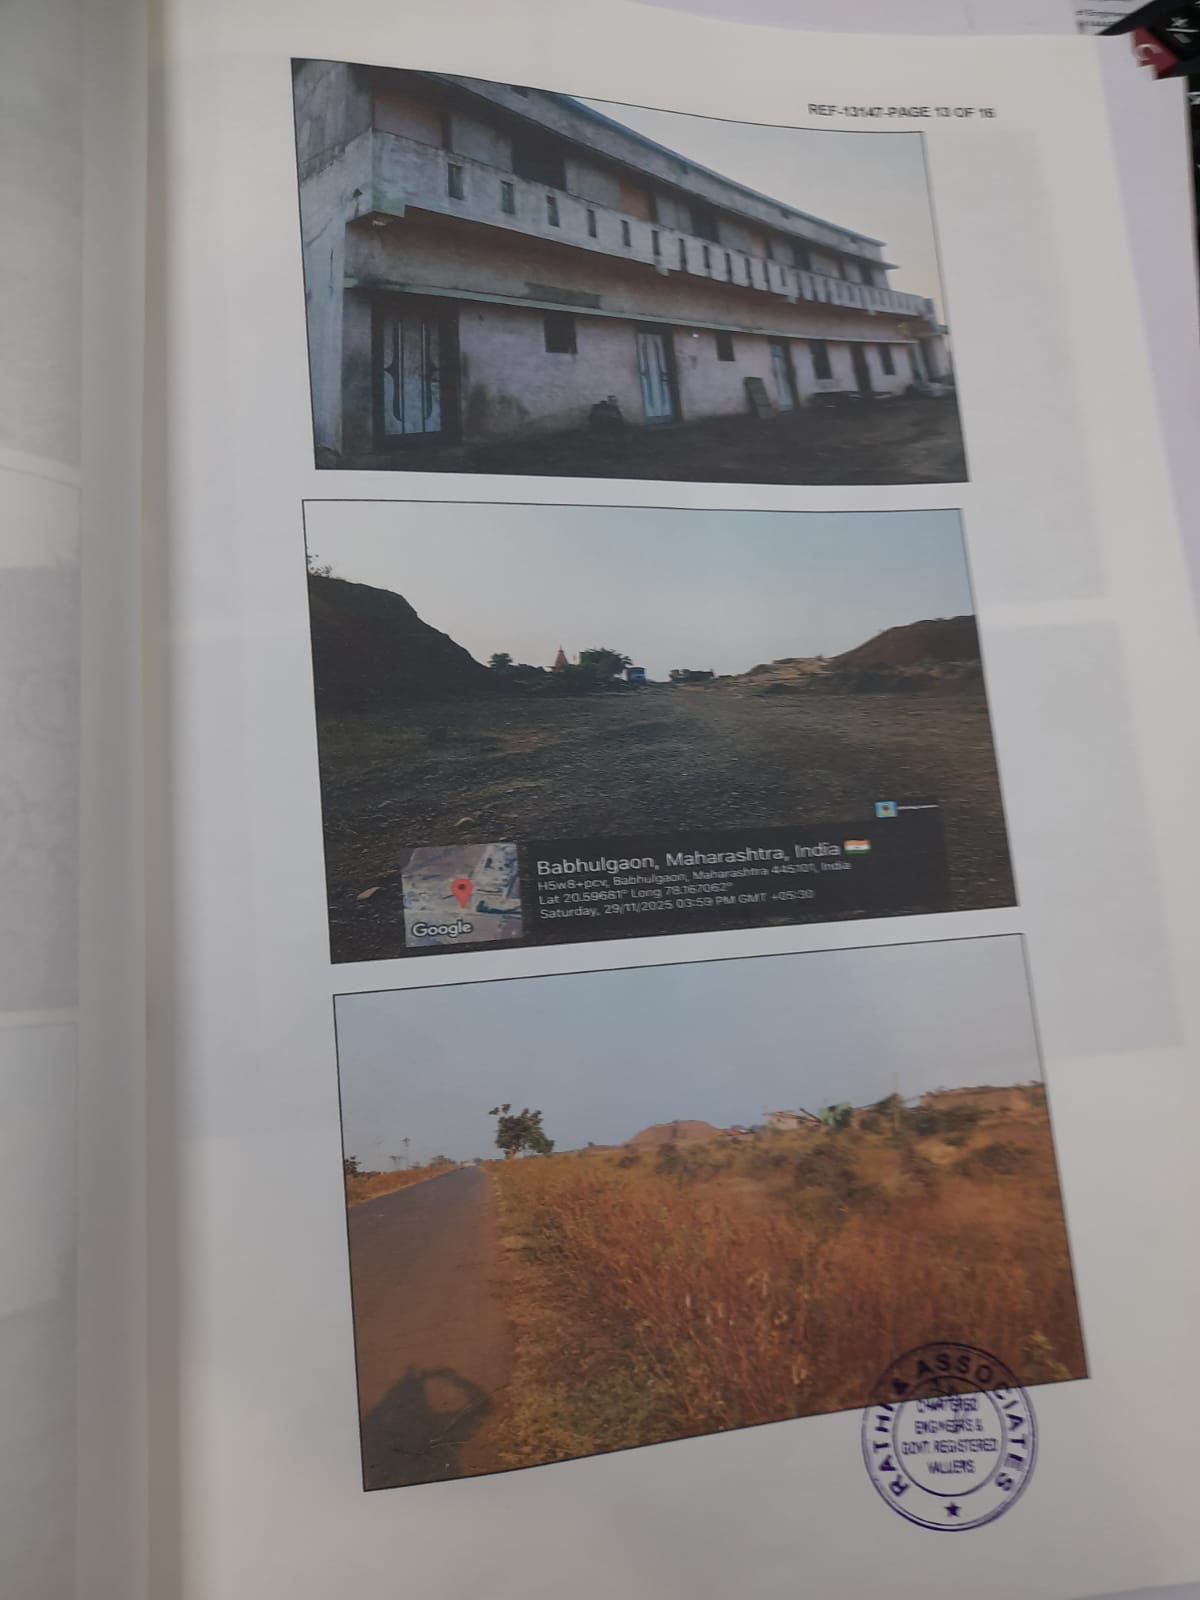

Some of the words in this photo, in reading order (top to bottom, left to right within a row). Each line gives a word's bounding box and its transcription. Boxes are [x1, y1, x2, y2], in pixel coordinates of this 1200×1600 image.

[935, 107, 951, 118] 13
[954, 107, 974, 118] OF
[978, 107, 996, 119] 16
[536, 856, 660, 876] Babhulgaon,
[665, 846, 791, 867] Maharashtra,
[794, 841, 841, 859] India
[612, 872, 690, 887] Babhulgaon,
[692, 865, 769, 880] Maharashtra
[538, 895, 560, 905] Lat
[630, 886, 663, 900] Long
[539, 905, 600, 919] Saturday,
[715, 894, 736, 905] PM
[738, 892, 767, 904] GMT
[412, 921, 473, 938] Google
